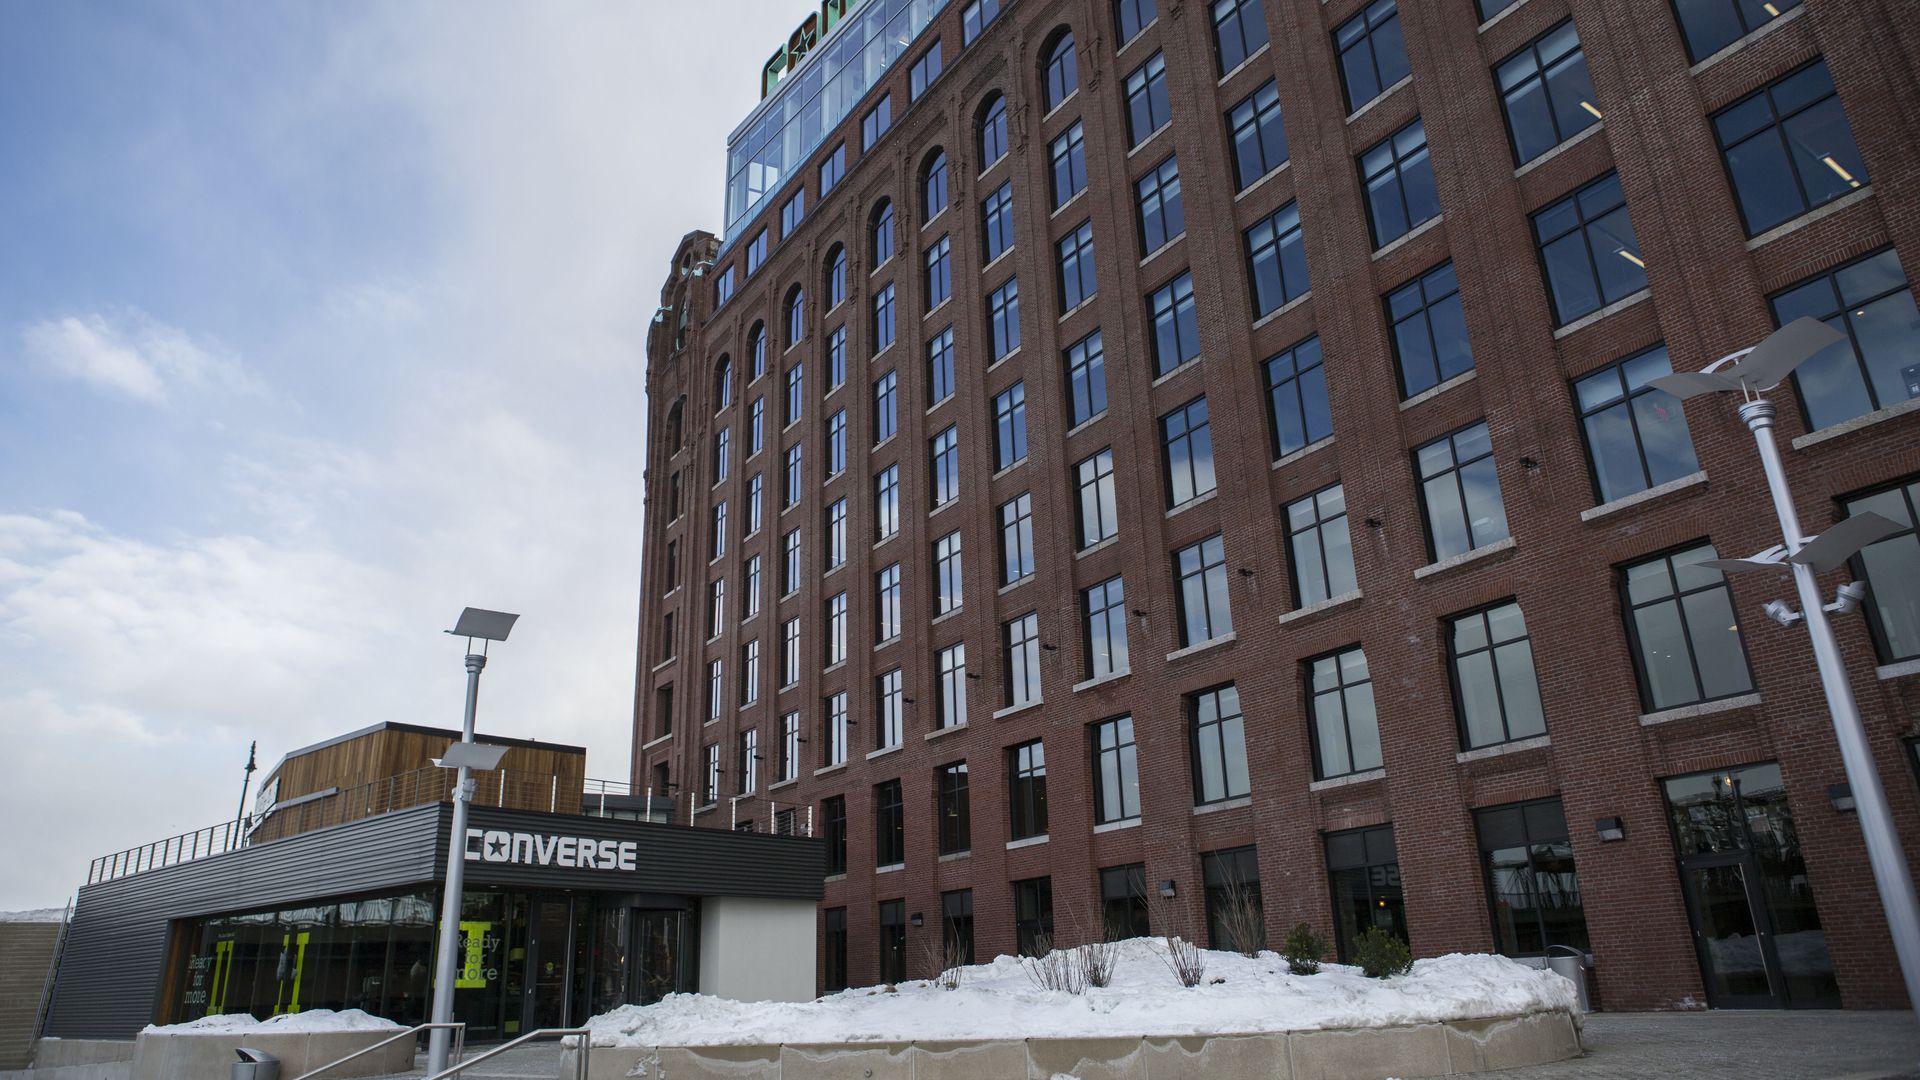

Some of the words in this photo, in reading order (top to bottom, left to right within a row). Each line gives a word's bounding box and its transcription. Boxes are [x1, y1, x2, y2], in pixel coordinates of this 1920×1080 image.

[464, 828, 637, 871] CONVERSE
[464, 949, 487, 965] for
[184, 989, 206, 1004] more
